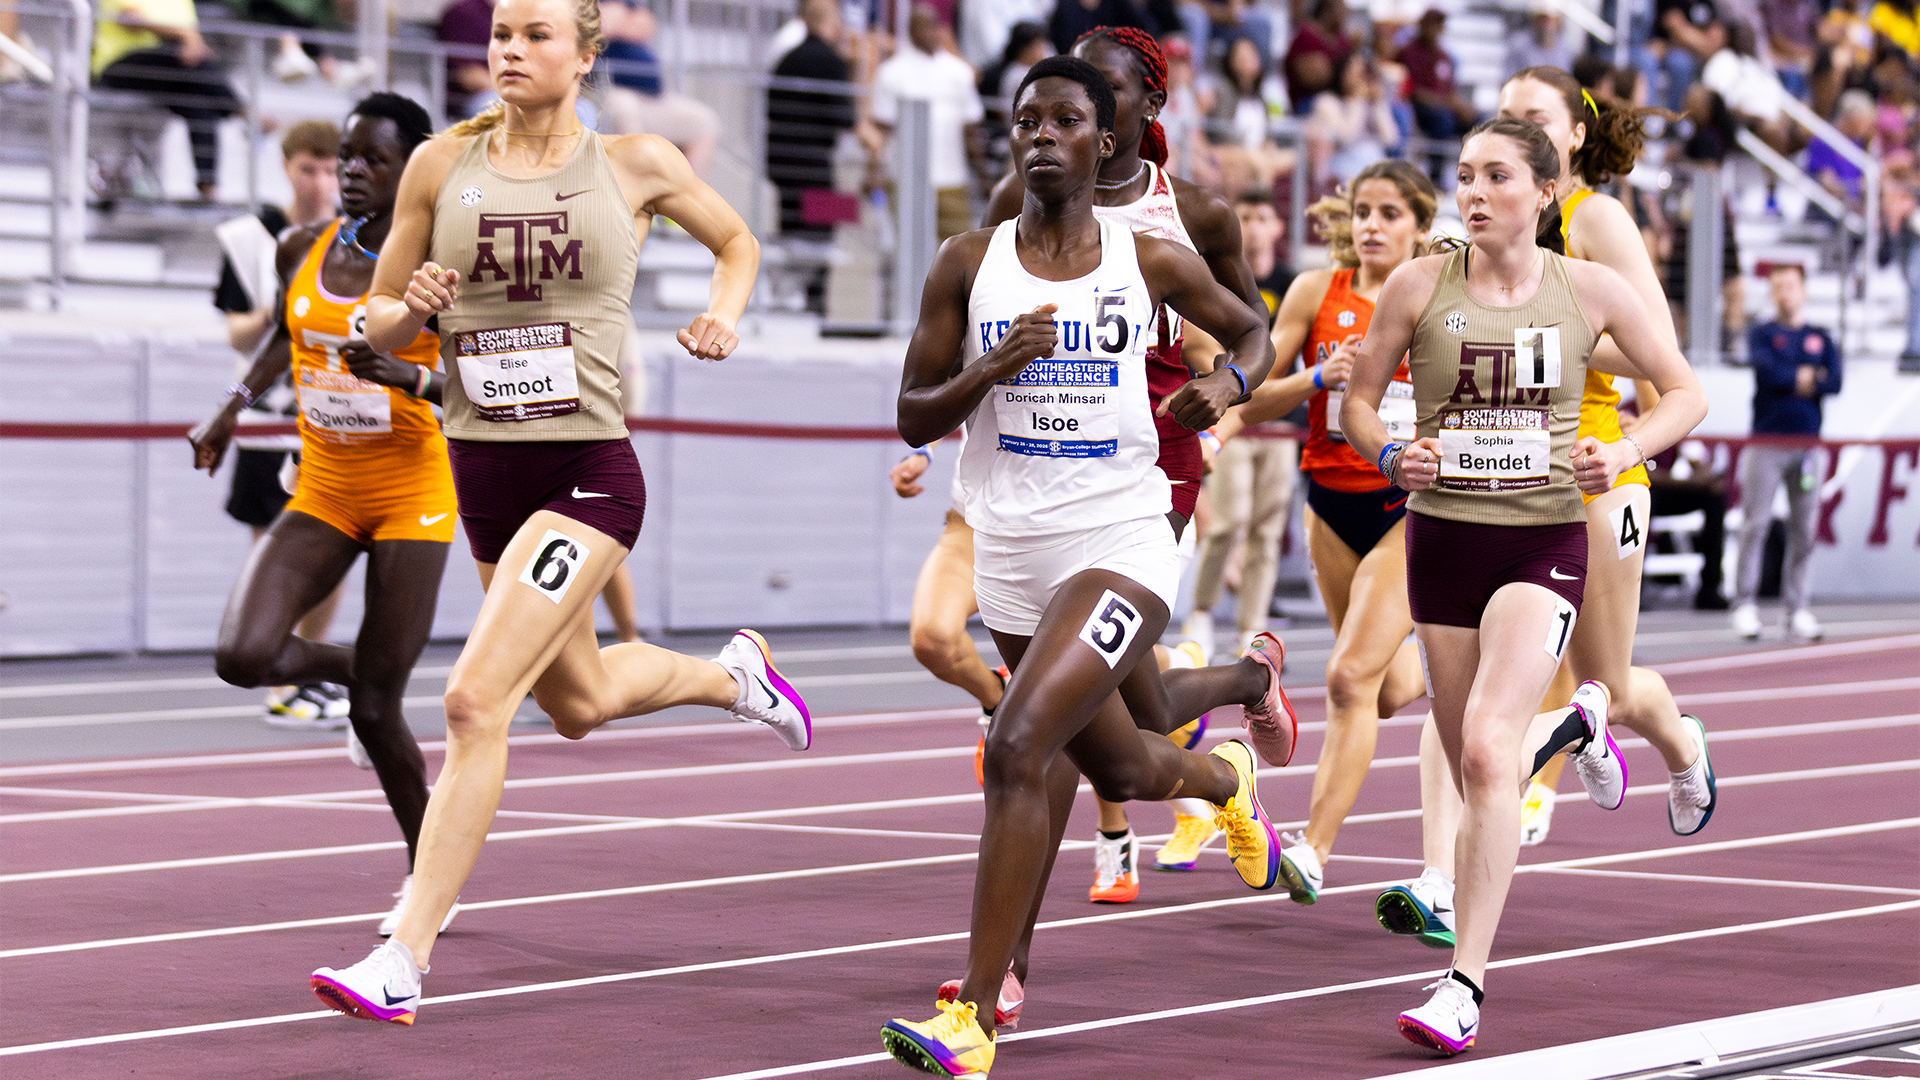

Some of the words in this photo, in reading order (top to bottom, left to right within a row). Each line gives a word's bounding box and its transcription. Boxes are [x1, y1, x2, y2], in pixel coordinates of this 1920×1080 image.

[1095, 296, 1128, 353] 5
[1446, 313, 1466, 333] SEC
[476, 325, 563, 341] SOUTHEASTERN
[478, 334, 564, 351] CONFERENCE
[500, 359, 528, 369] Elise
[1522, 332, 1544, 383] 1
[1019, 372, 1110, 382] CONFERENCE
[483, 376, 553, 398] Smoot
[1006, 392, 1054, 403] Doricah
[1059, 393, 1105, 404] Minsari
[1032, 412, 1079, 431] Isoe
[1462, 417, 1541, 427] CONFERENCE
[1463, 409, 1541, 418] SOUTHEASTERN
[1474, 435, 1514, 447] Sophia
[1459, 453, 1531, 470] Bendet
[1620, 503, 1640, 547] 4
[532, 539, 578, 591] 6
[1091, 597, 1135, 653] 5
[1556, 610, 1572, 657] 1
